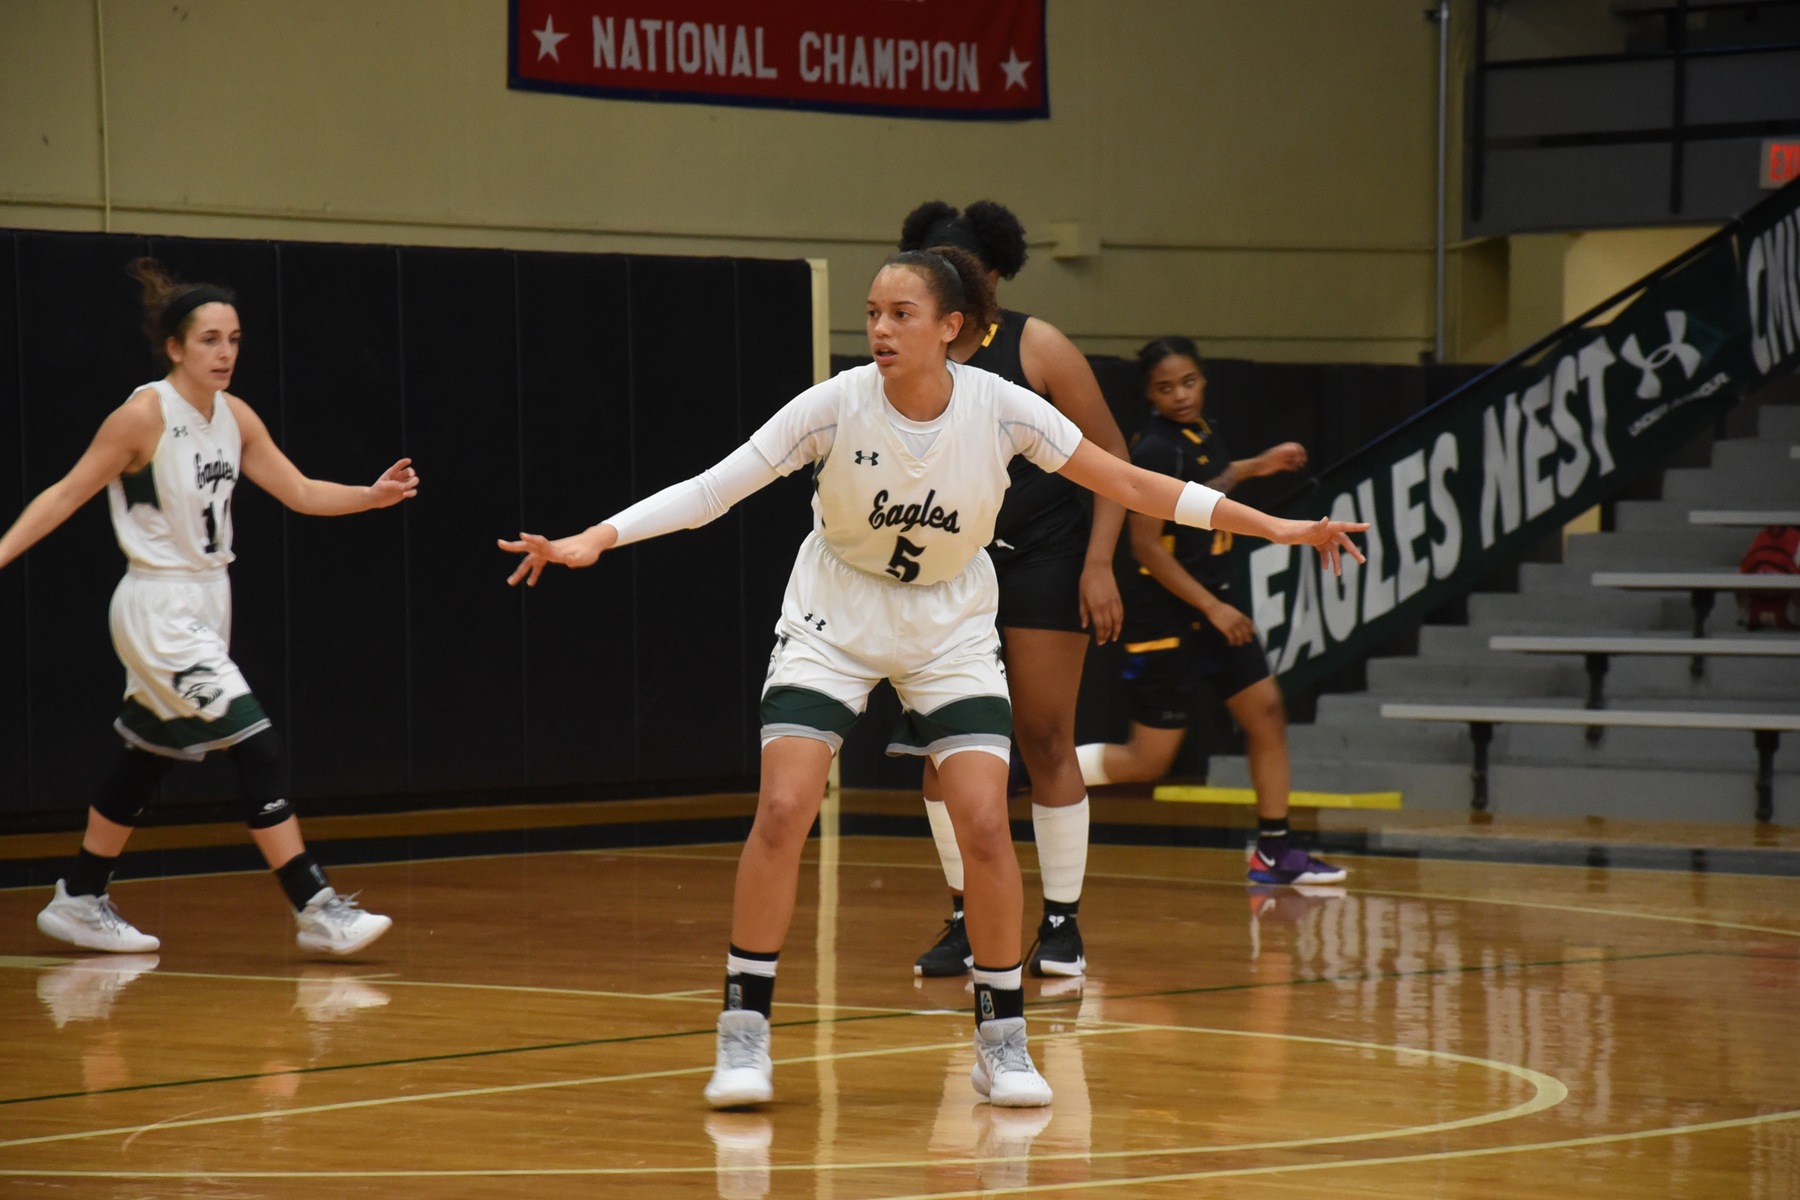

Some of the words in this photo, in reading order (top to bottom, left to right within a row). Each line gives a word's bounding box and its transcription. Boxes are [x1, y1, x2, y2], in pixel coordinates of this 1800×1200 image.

[592, 15, 778, 80] NATIONAL
[800, 31, 981, 93] CHAMPION
[868, 489, 960, 534] Eagles
[1249, 431, 1462, 676] EAGLES
[1480, 335, 1617, 550] NEST
[885, 535, 927, 583] 5
